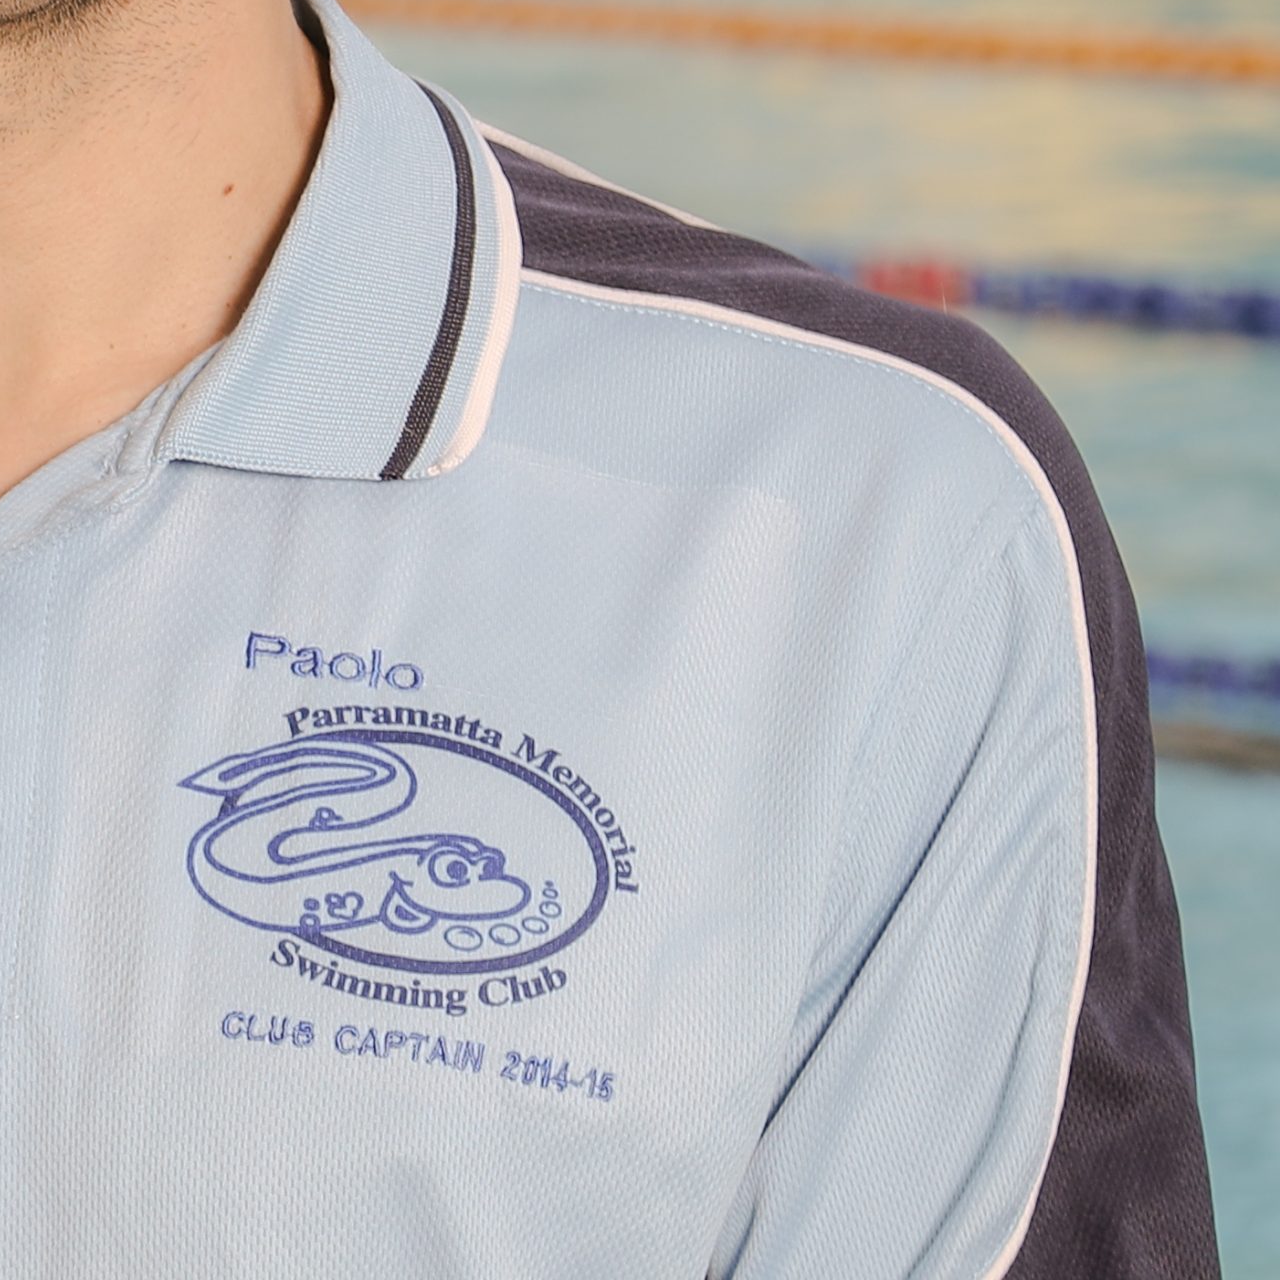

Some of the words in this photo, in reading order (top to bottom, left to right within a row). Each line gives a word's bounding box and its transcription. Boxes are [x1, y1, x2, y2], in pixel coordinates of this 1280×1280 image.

[244, 631, 424, 691] Paolo
[282, 704, 504, 748] Parramatta
[513, 732, 640, 896] Memorial
[269, 939, 468, 1016] Swimming
[478, 965, 568, 1006] Club
[221, 1010, 315, 1048] CLUB
[334, 1025, 486, 1073] CAPTAIN
[500, 1051, 617, 1102] 2014-15
